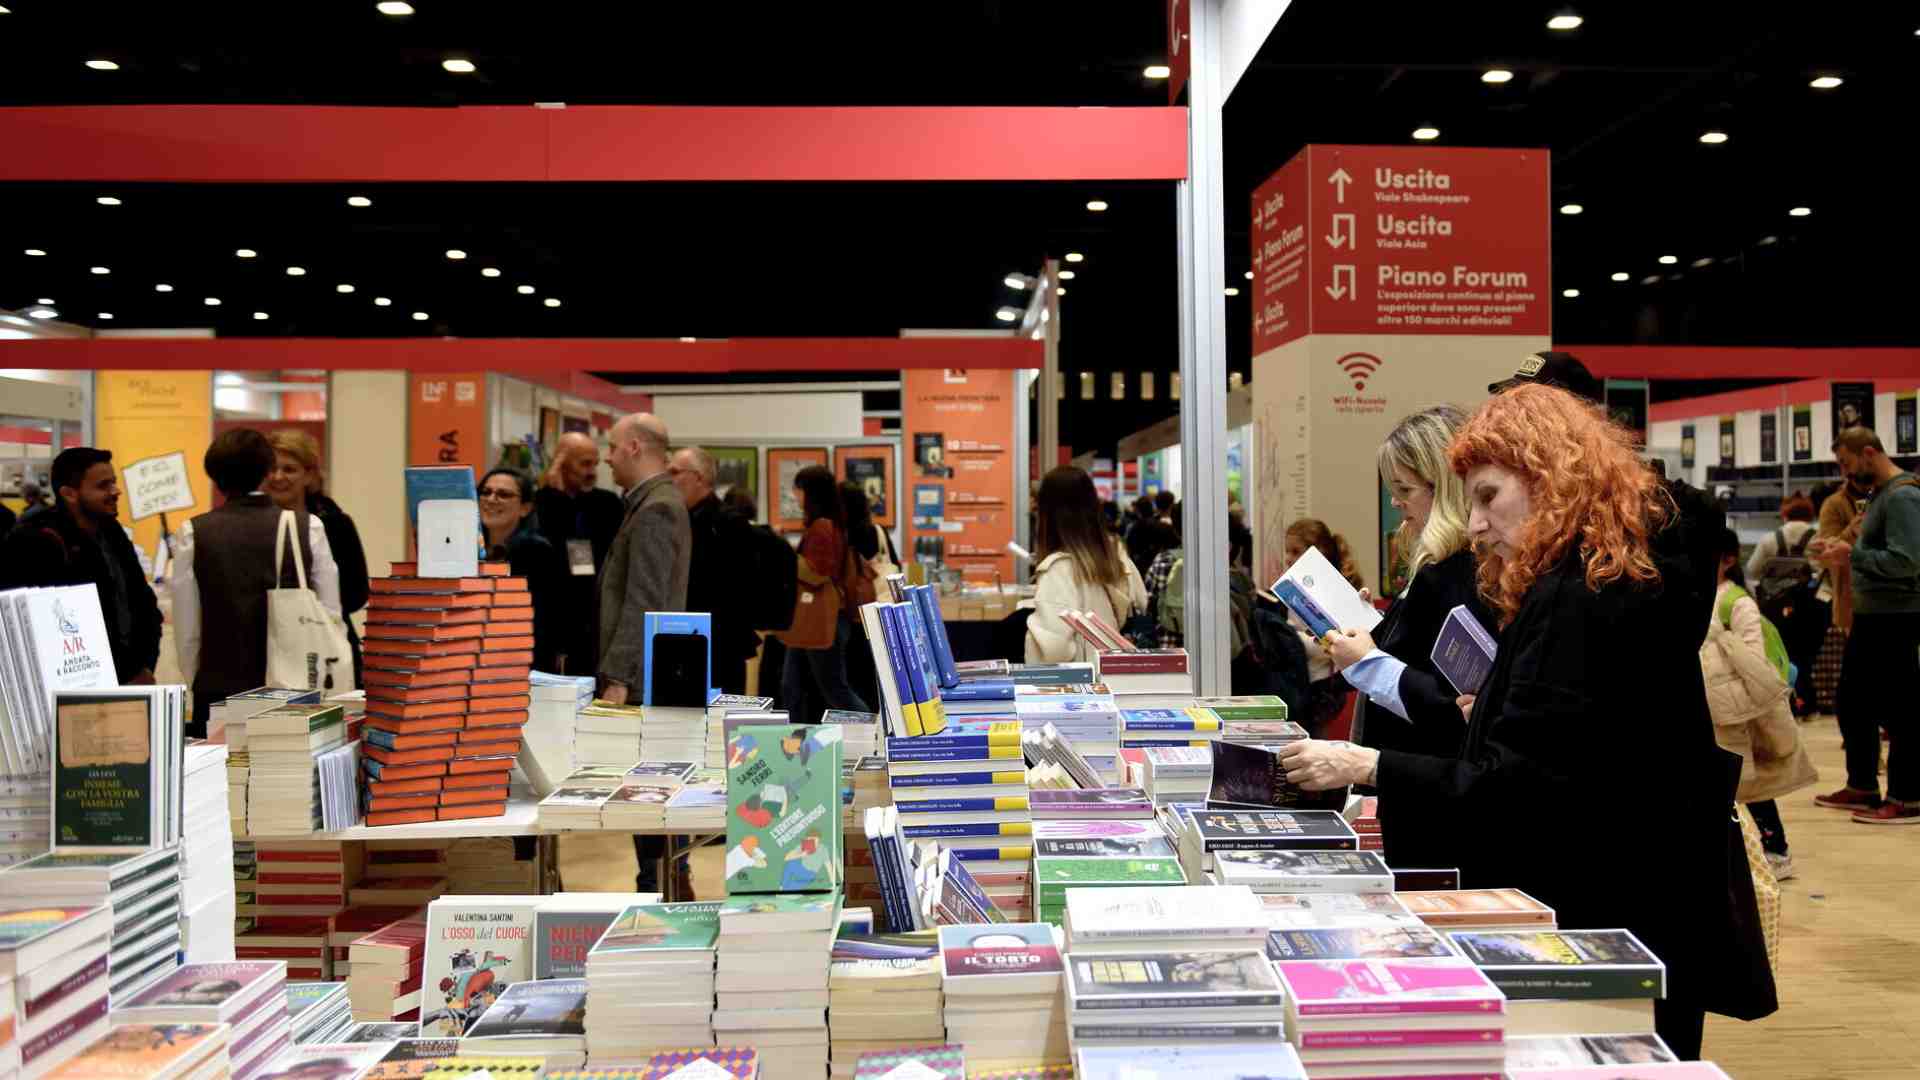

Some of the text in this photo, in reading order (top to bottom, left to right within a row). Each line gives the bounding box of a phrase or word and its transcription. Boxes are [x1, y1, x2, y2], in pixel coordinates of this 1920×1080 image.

[1375, 168, 1450, 189] Uscita
[1374, 192, 1471, 204] Viale Shakespeare
[1377, 214, 1452, 235] Uscita
[1376, 239, 1427, 249] Viale Asia
[1378, 265, 1527, 287] Piano Forum
[1377, 290, 1444, 300] L'esposizione
[1505, 292, 1536, 302] piano
[1377, 302, 1526, 314] superiore dove sono presenti
[736, 759, 767, 785] SANDRO
[751, 767, 773, 786] FERRI
[454, 913, 514, 922] VALENTINA SANTINI
[441, 927, 475, 940] L'OSSO
[495, 927, 528, 940] CUORE
[964, 955, 1041, 965] IL TORTO
